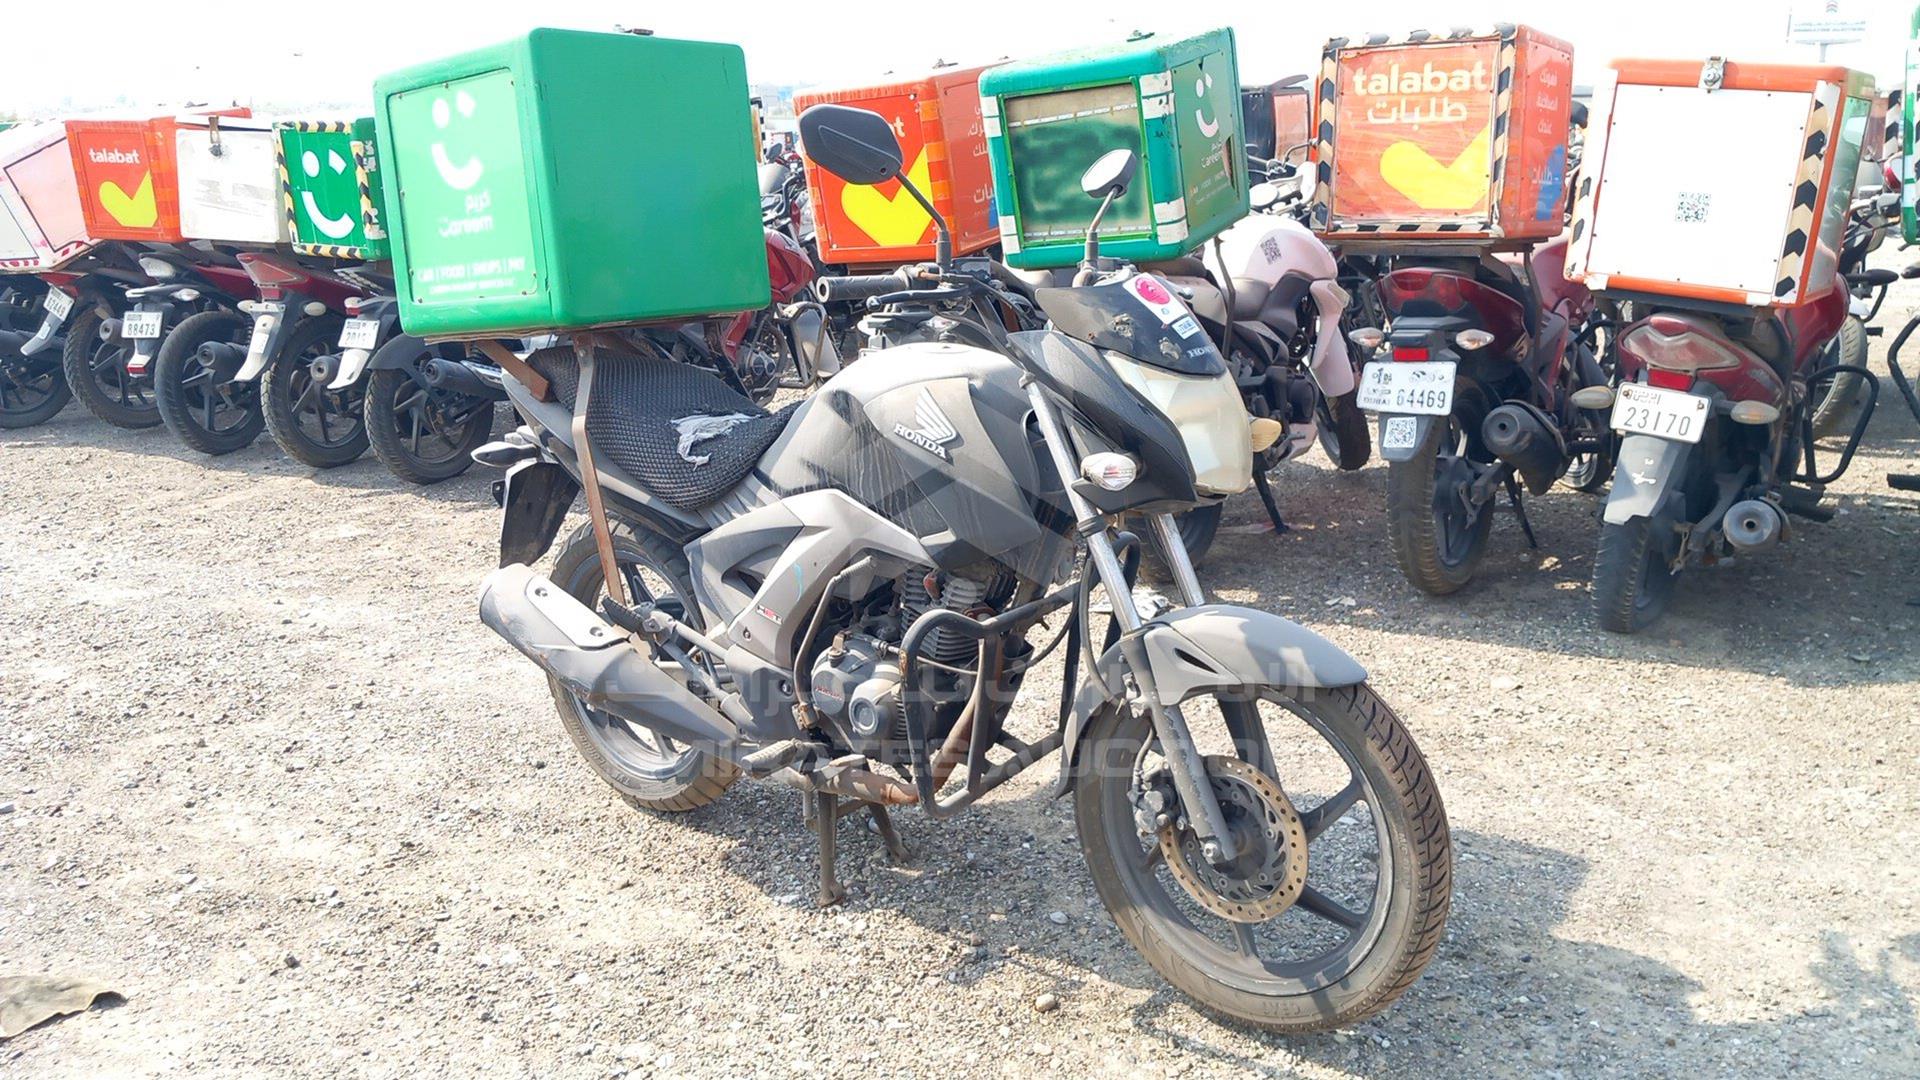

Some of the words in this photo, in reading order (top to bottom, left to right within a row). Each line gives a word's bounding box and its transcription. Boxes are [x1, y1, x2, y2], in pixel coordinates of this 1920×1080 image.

[1353, 61, 1488, 96] talabat
[1367, 96, 1468, 131] طلبات
[89, 147, 140, 164] talabat
[1397, 389, 1446, 409] 64469
[1624, 407, 1691, 436] 23170
[894, 423, 947, 459] HONDA
